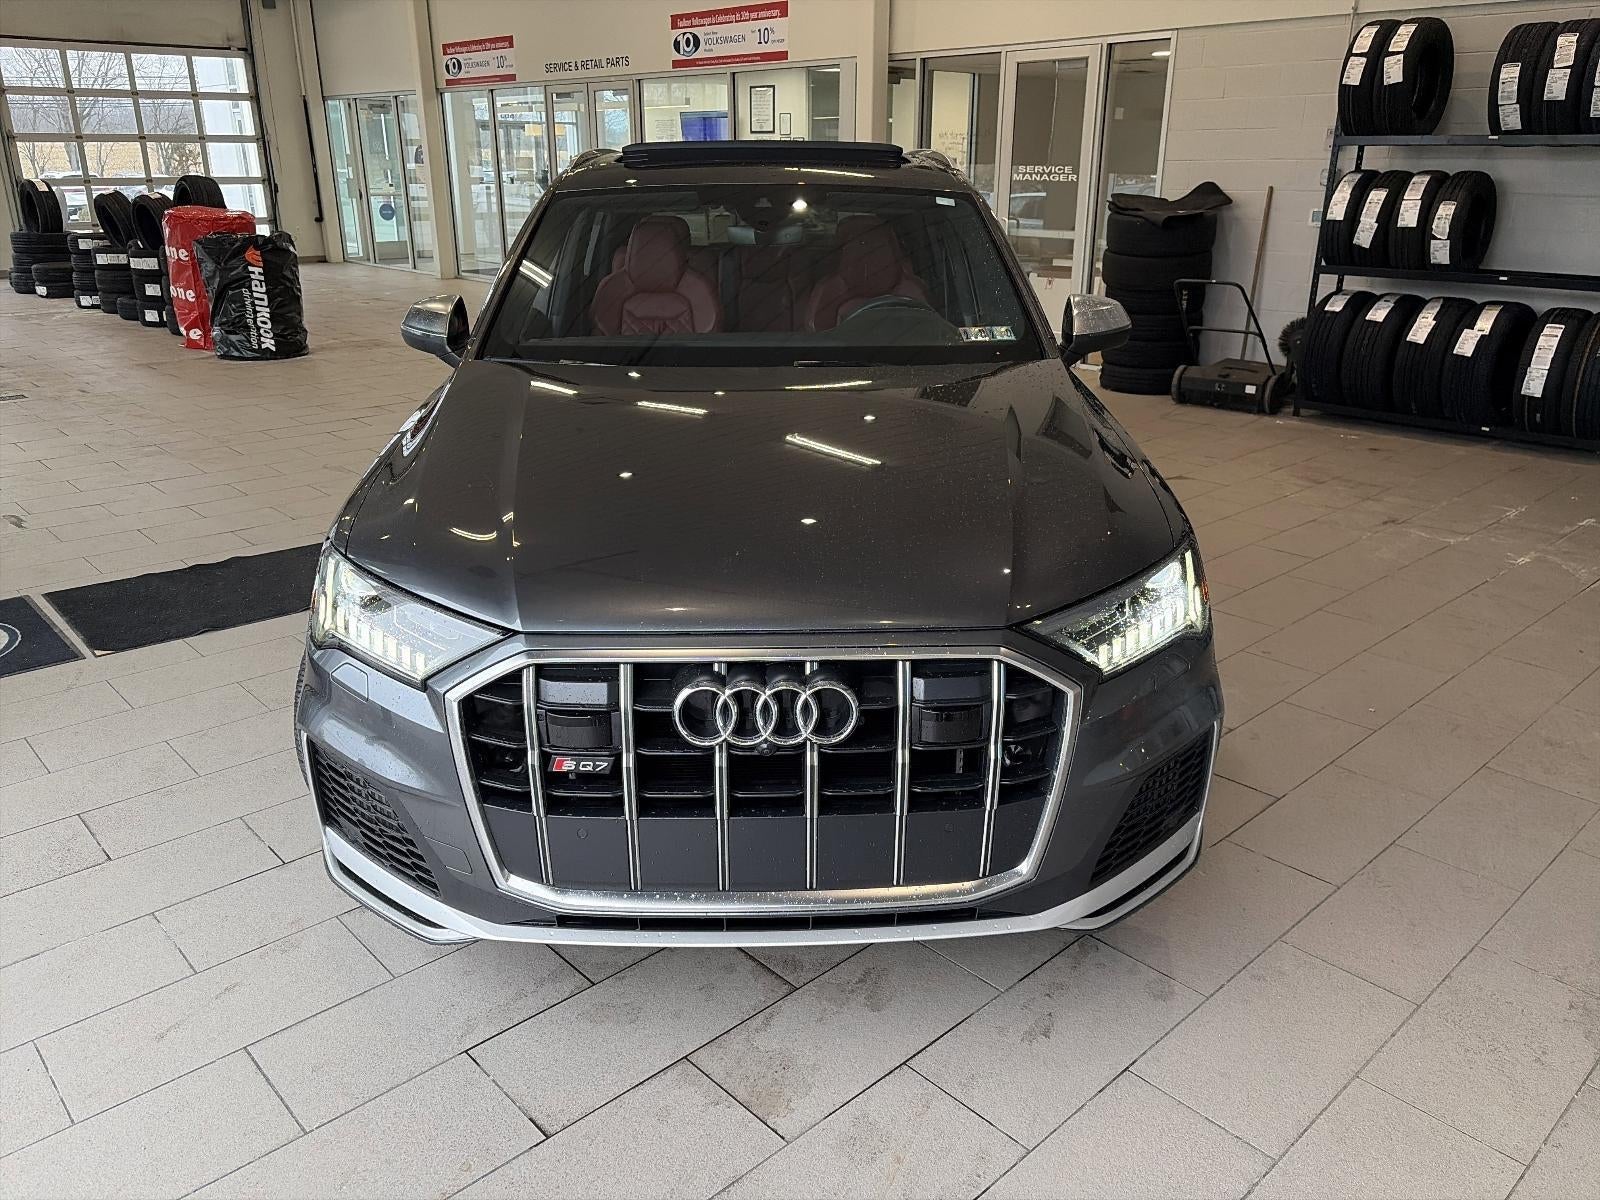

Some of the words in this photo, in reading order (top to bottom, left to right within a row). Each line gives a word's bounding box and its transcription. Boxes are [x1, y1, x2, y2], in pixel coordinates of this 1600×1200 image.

[716, 12, 736, 23] Celebrating
[703, 34, 746, 46] VOLKSWAGEN
[544, 61, 573, 73] SERVICE
[573, 60, 579, 71] &
[580, 58, 605, 70] RETAIL
[606, 56, 630, 68] PARTS
[1018, 165, 1073, 174] SERVICE
[1013, 173, 1078, 182] MANAGER
[247, 265, 276, 352] Hankook
